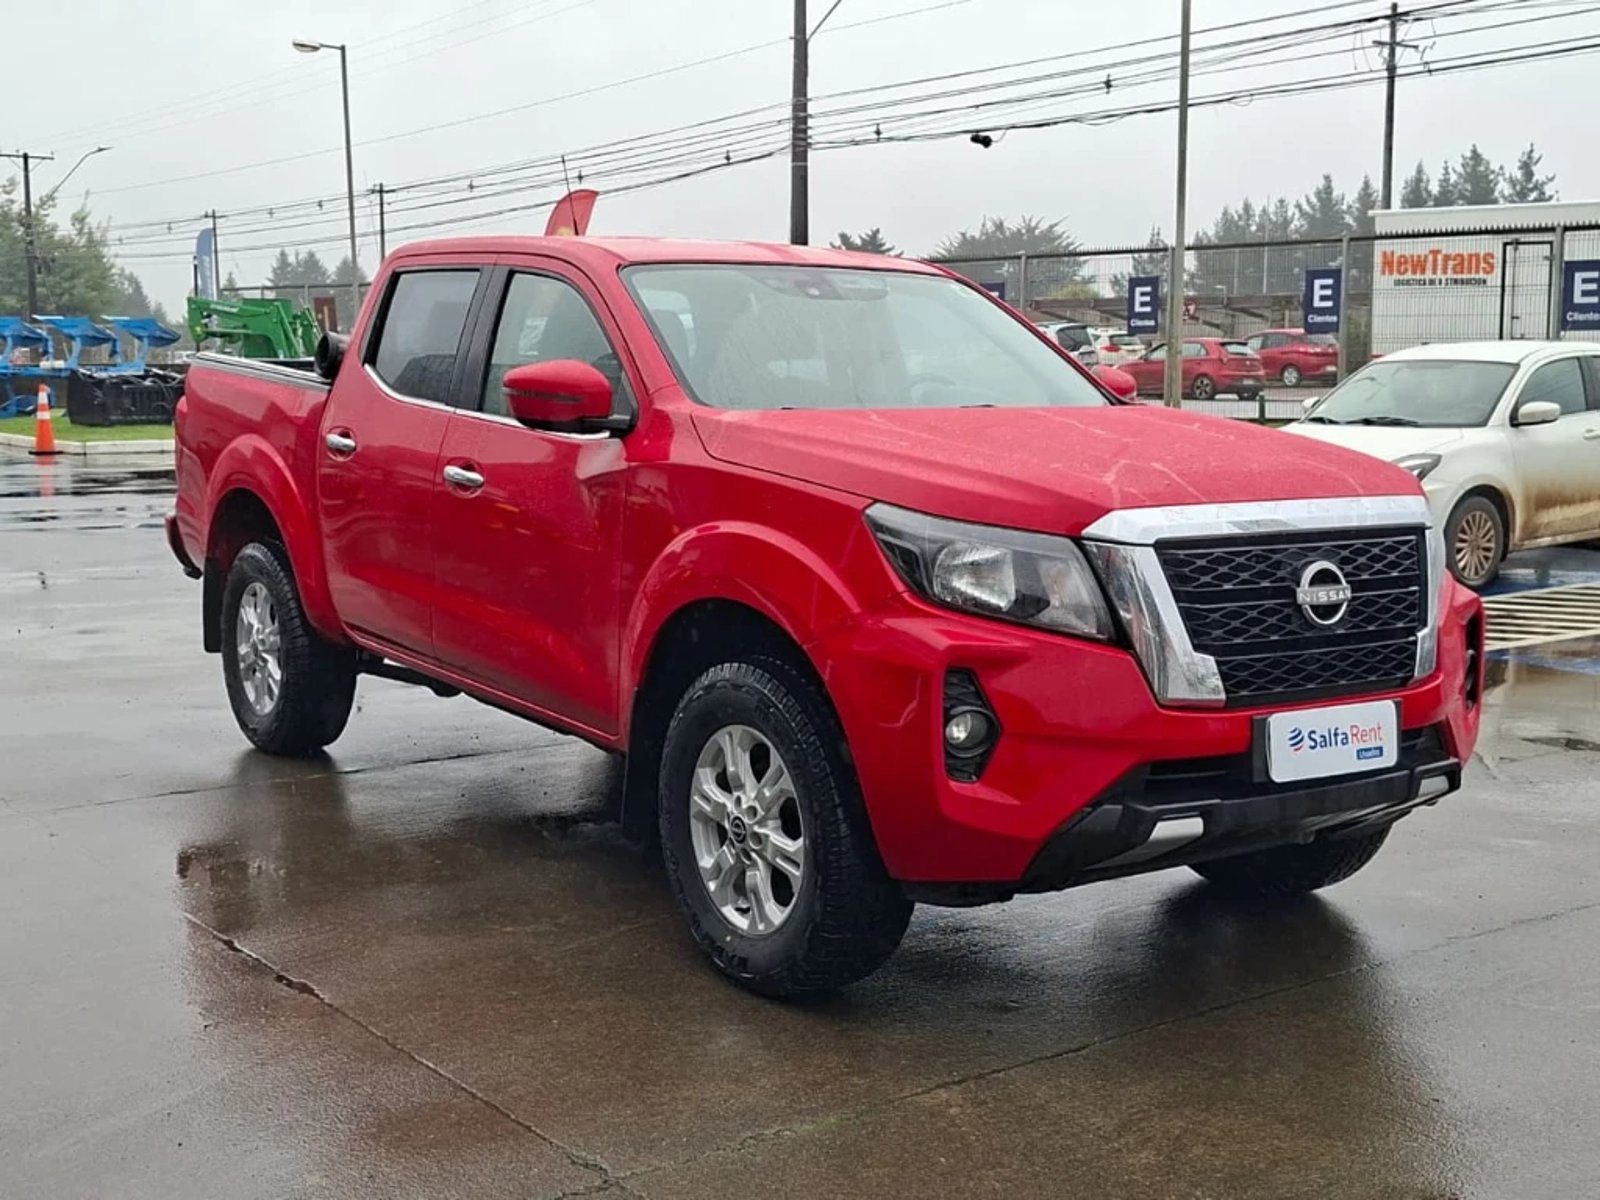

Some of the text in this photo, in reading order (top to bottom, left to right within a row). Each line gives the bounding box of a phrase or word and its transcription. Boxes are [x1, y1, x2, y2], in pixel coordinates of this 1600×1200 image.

[1381, 249, 1495, 275] NewTrans
[1313, 278, 1334, 307] E
[1438, 278, 1487, 286] DSTRIBUCION
[1573, 271, 1600, 304] E
[1134, 286, 1152, 313] E
[1300, 588, 1351, 603] NISSAN
[1307, 721, 1384, 750] SalfaRent
